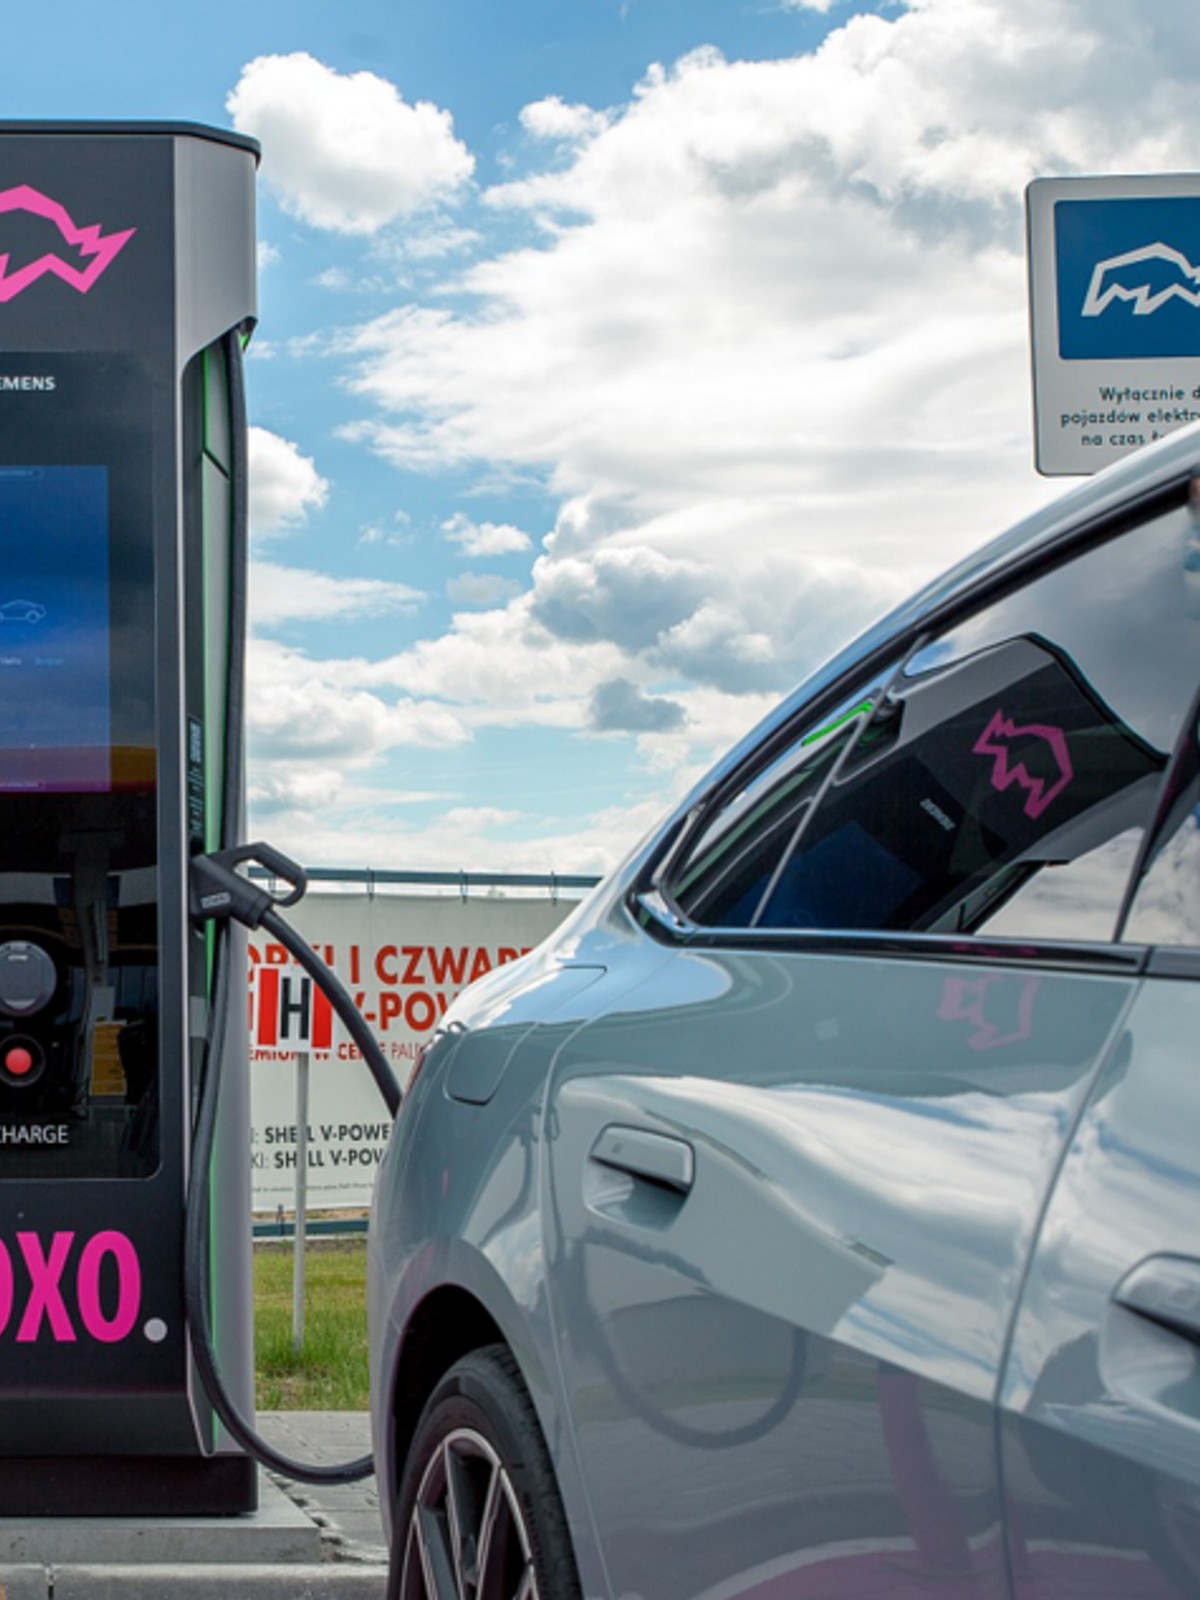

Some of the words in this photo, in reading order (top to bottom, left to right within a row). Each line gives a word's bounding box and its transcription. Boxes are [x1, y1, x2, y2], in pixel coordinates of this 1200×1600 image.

[1061, 409, 1140, 428] pojazdów
[1081, 434, 1102, 446] na
[1109, 434, 1145, 446] czas
[265, 1125, 315, 1144] SHEL
[274, 1149, 325, 1169] SHLL
